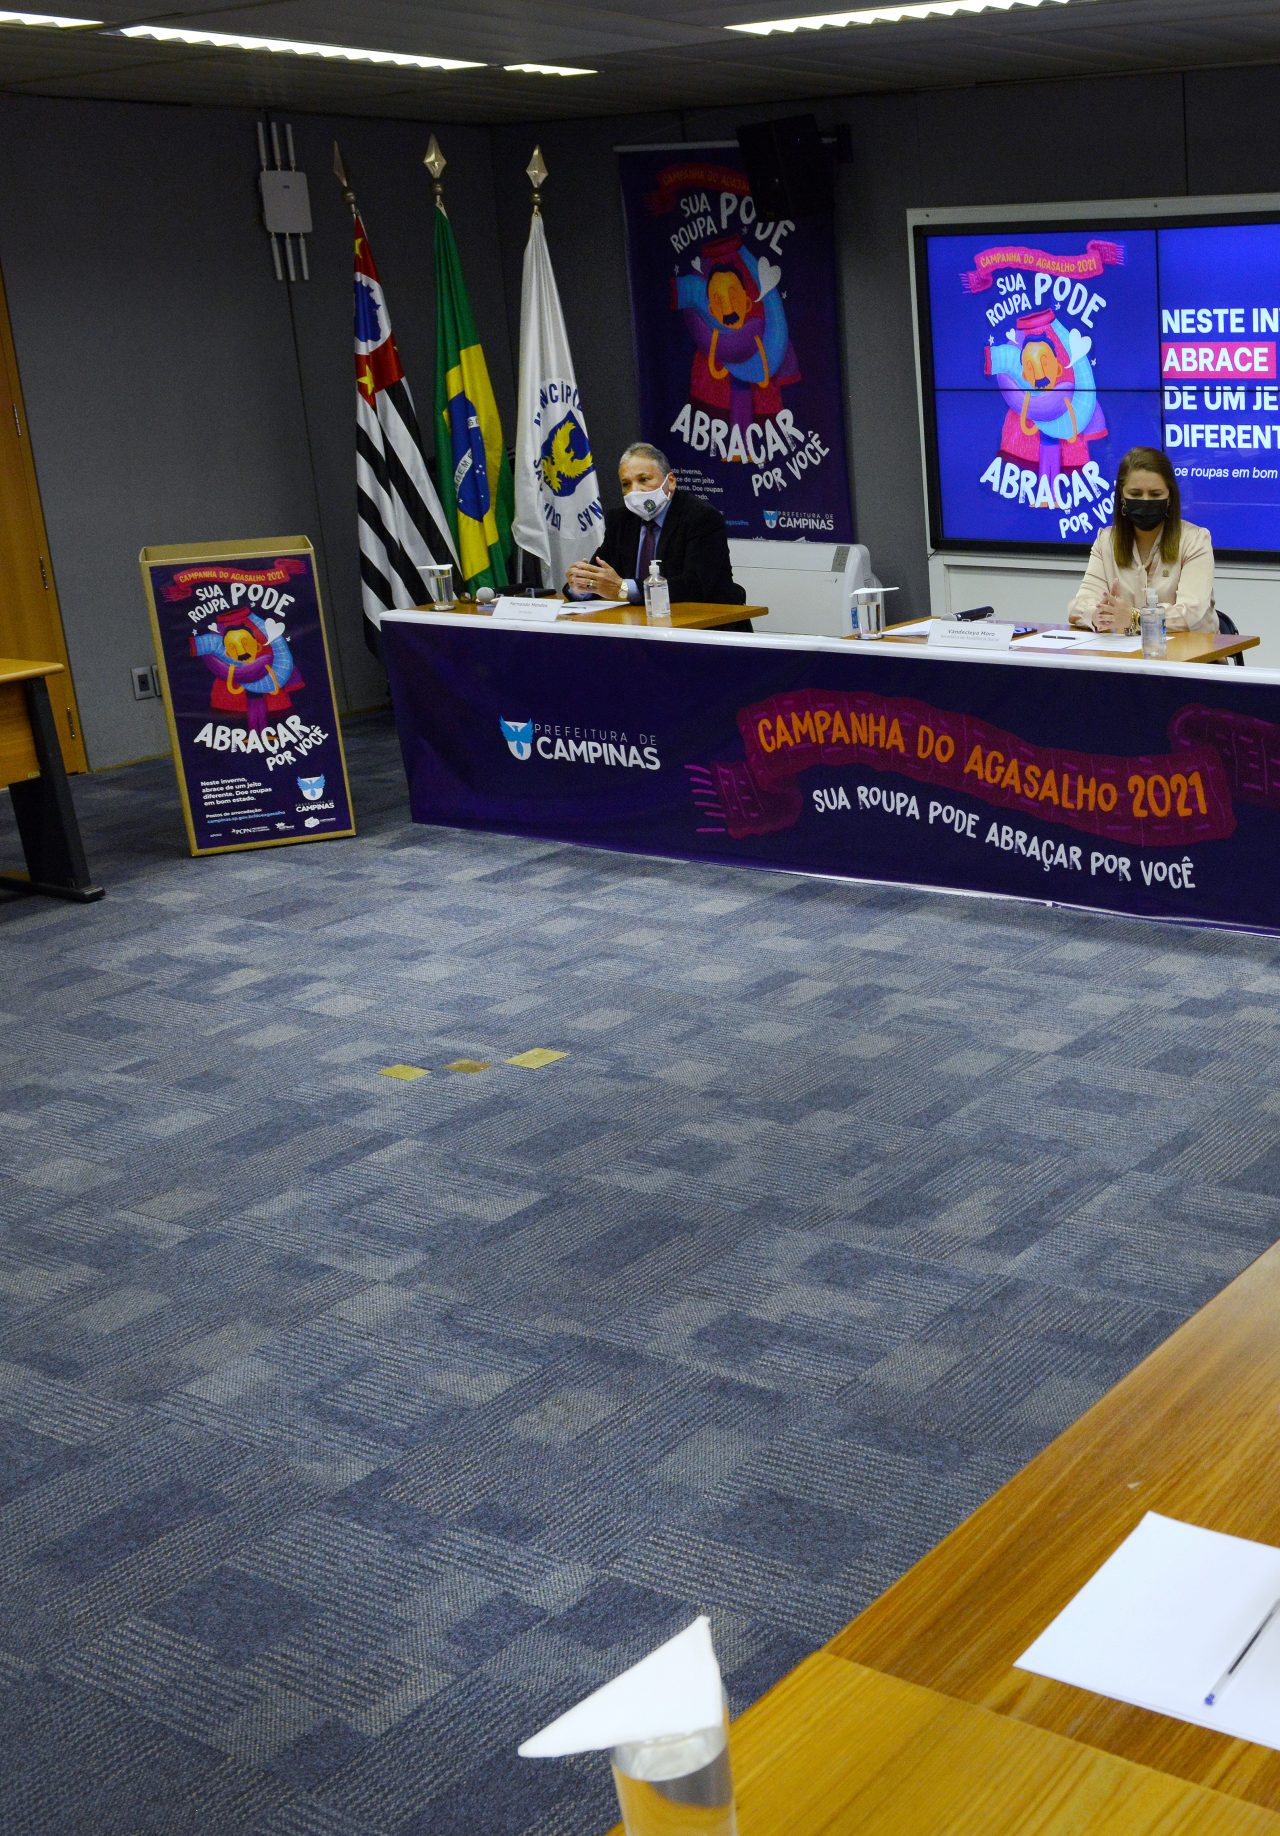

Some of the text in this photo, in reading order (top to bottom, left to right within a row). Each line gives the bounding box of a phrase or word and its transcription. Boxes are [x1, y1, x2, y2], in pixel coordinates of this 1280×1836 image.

[680, 192, 712, 218] SUA
[670, 215, 718, 254] ROUPA
[980, 253, 1097, 273] CAMPANHA DO AGASALHO 2021
[985, 292, 1032, 328] ROUPA
[996, 273, 1107, 329] SUA PODE
[1162, 308, 1245, 335] NESTE
[1163, 347, 1269, 373] ABRACE
[1164, 386, 1198, 411] DE
[1203, 386, 1246, 411] UM
[670, 403, 806, 469] ABRAÇAR
[751, 431, 830, 497] POR VOCÊ
[1173, 467, 1188, 477] oe
[1190, 467, 1229, 480] roupas
[1232, 468, 1250, 478] em
[1252, 467, 1278, 479] bom
[979, 456, 1110, 515] ABRAÇAR
[778, 510, 821, 519] PREFEITURA
[778, 517, 834, 531] CAMPINAS
[1059, 512, 1093, 539] POR
[179, 570, 285, 583] CAMPANHA DO AGASALHO 2021
[188, 598, 231, 623] ROUPA
[196, 583, 295, 617] SUA PODE
[193, 714, 311, 754] ABRAÇAR
[534, 723, 657, 747] PREFEITURA DE
[266, 724, 329, 772] POR VOCÊ
[536, 736, 661, 770] CAMPINAS
[756, 711, 1209, 819] CAMPANHA DO AGASALHO 2021
[250, 787, 273, 795] roupas
[296, 802, 335, 813] CAMPINAS
[811, 785, 1197, 889] SUA ROUPA PODE ABRAÇAR POR VOCÊ
